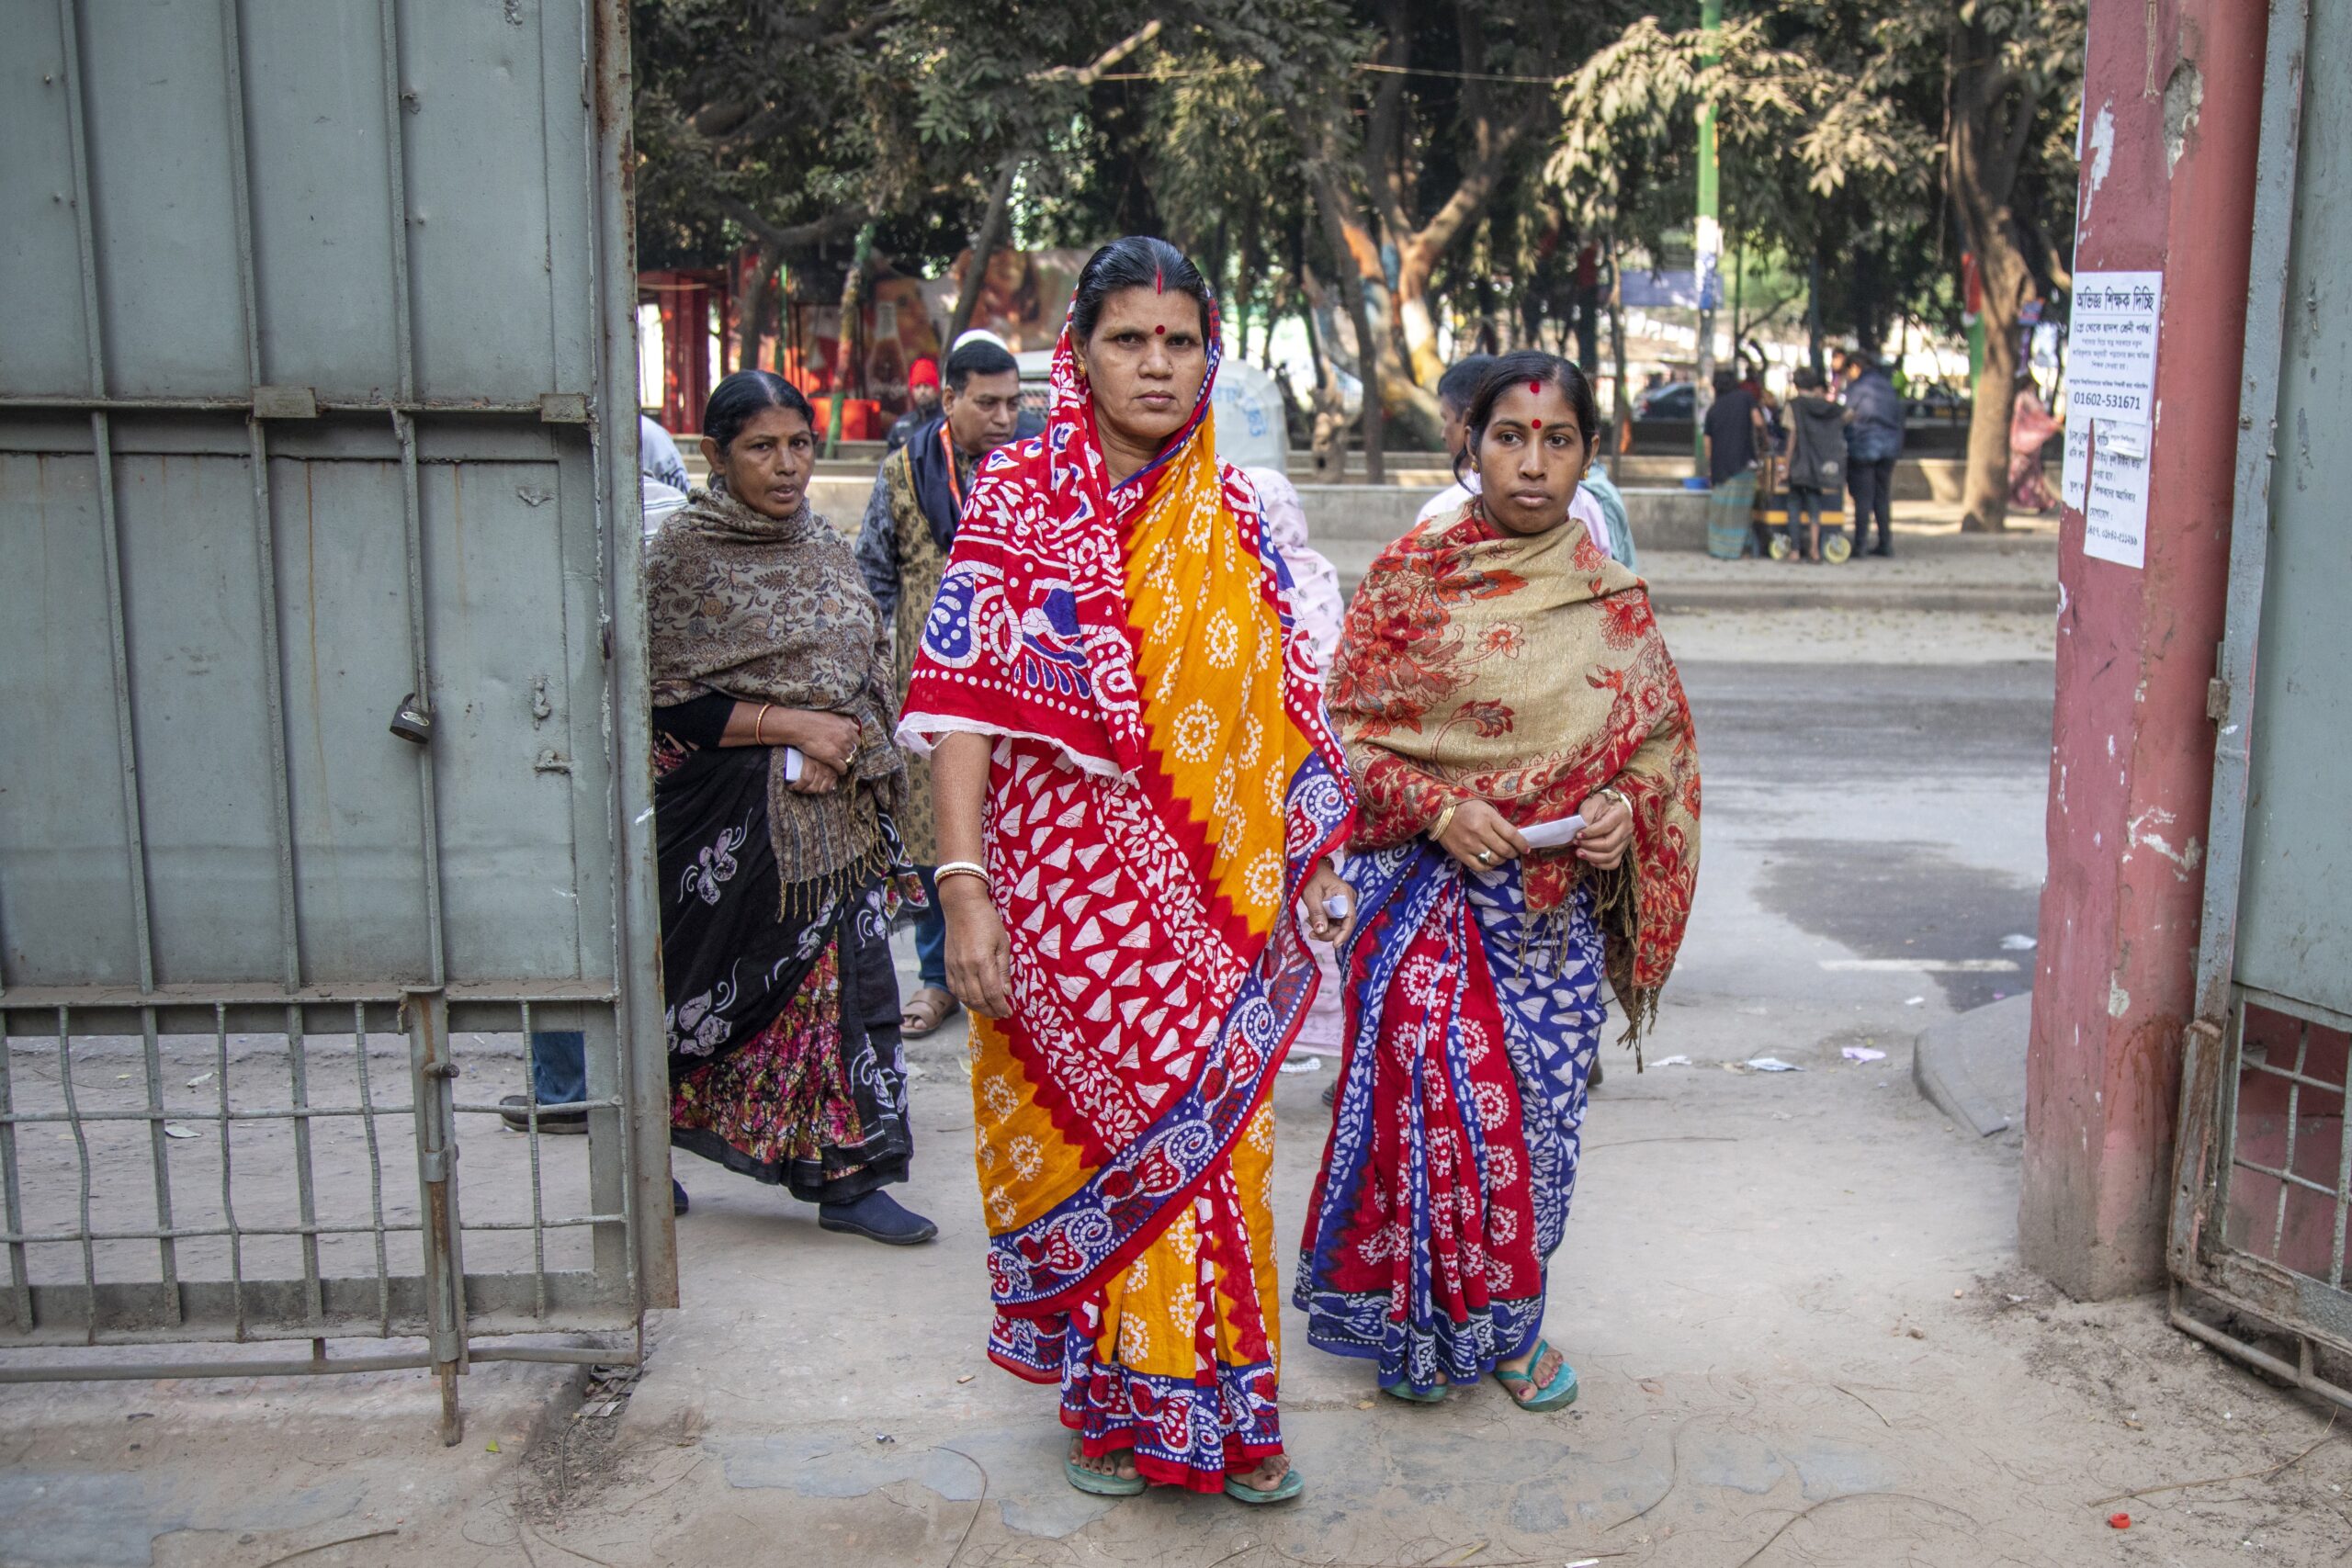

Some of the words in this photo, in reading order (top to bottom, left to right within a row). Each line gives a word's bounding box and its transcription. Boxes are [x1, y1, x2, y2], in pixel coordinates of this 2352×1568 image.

[2075, 286, 2102, 309] অভিজ্ঞ
[2104, 286, 2132, 310] শিক্ষক
[2132, 286, 2155, 312] দিচ্ছি
[2085, 322, 2101, 333] থেকে
[2074, 391, 2141, 410] 01602-531671
